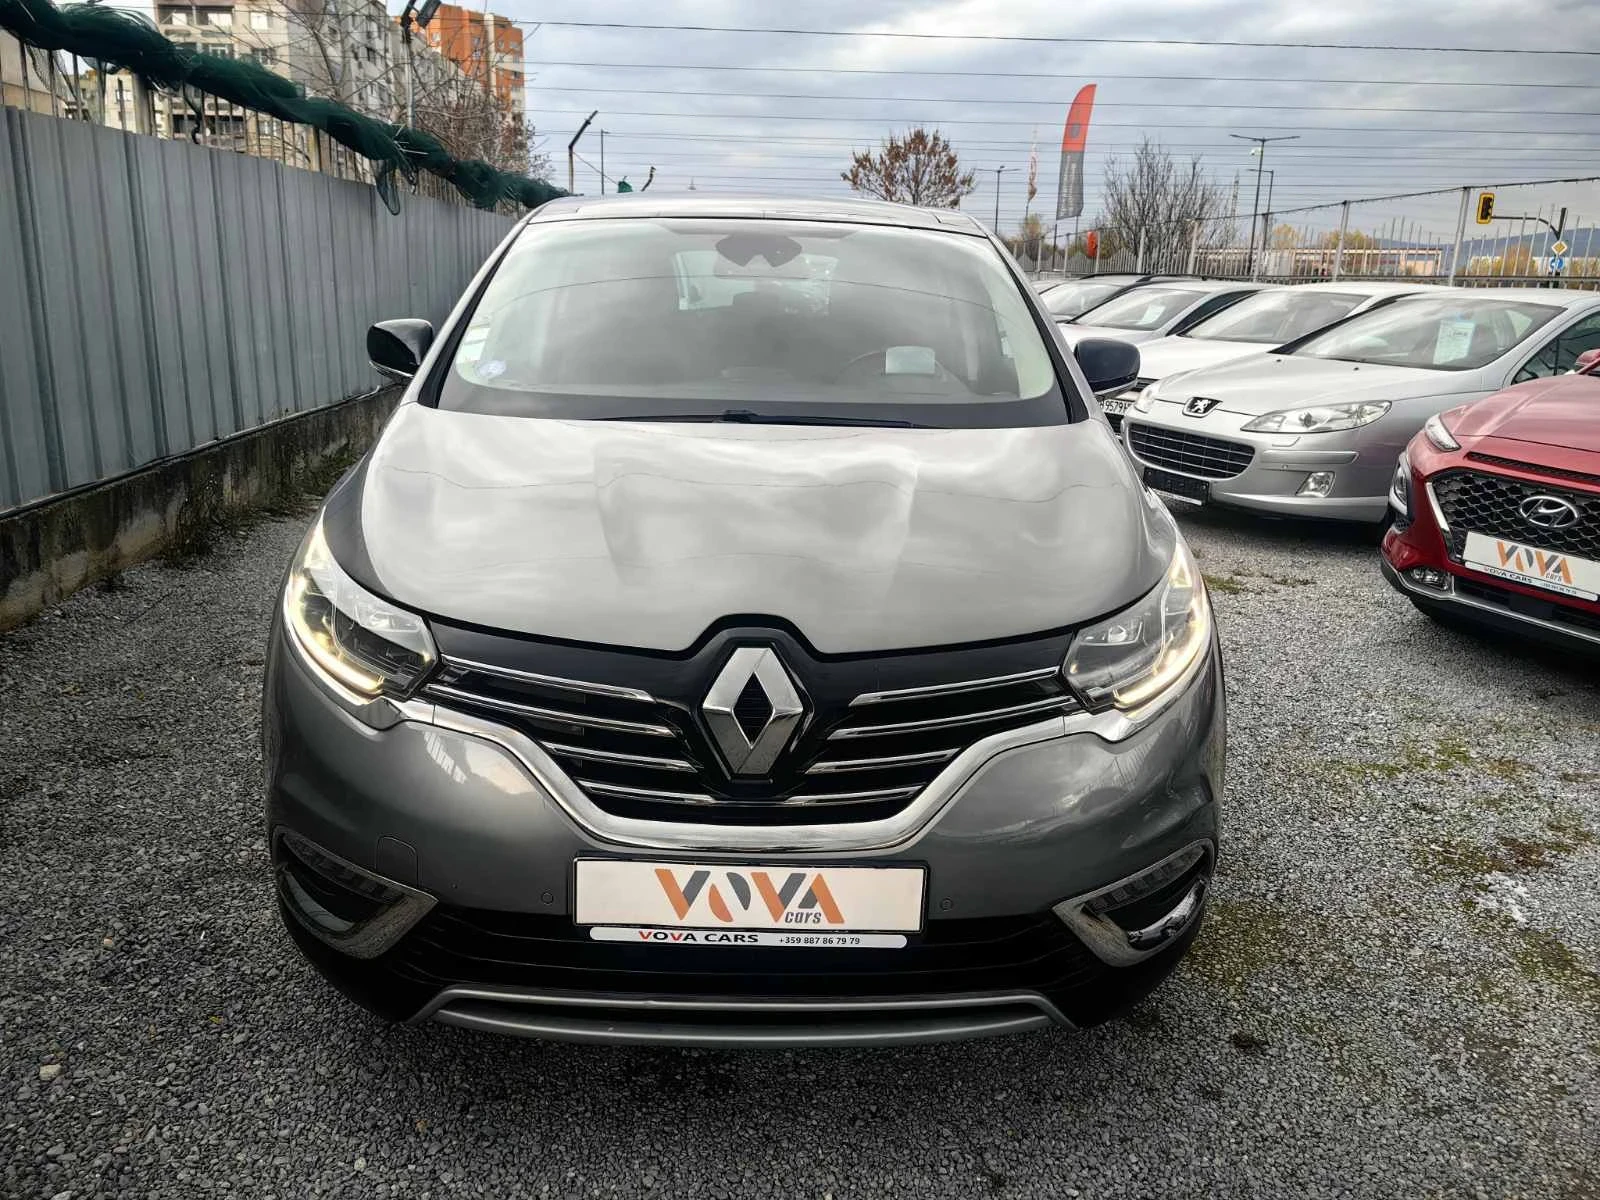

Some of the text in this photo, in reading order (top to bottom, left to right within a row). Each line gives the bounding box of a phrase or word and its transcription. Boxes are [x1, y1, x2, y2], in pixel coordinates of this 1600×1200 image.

[1496, 540, 1572, 584] VOVA
[654, 868, 845, 924] VOVA
[784, 910, 822, 924] cars
[638, 930, 861, 946] VOVA CARS +359 887 86 79 79
